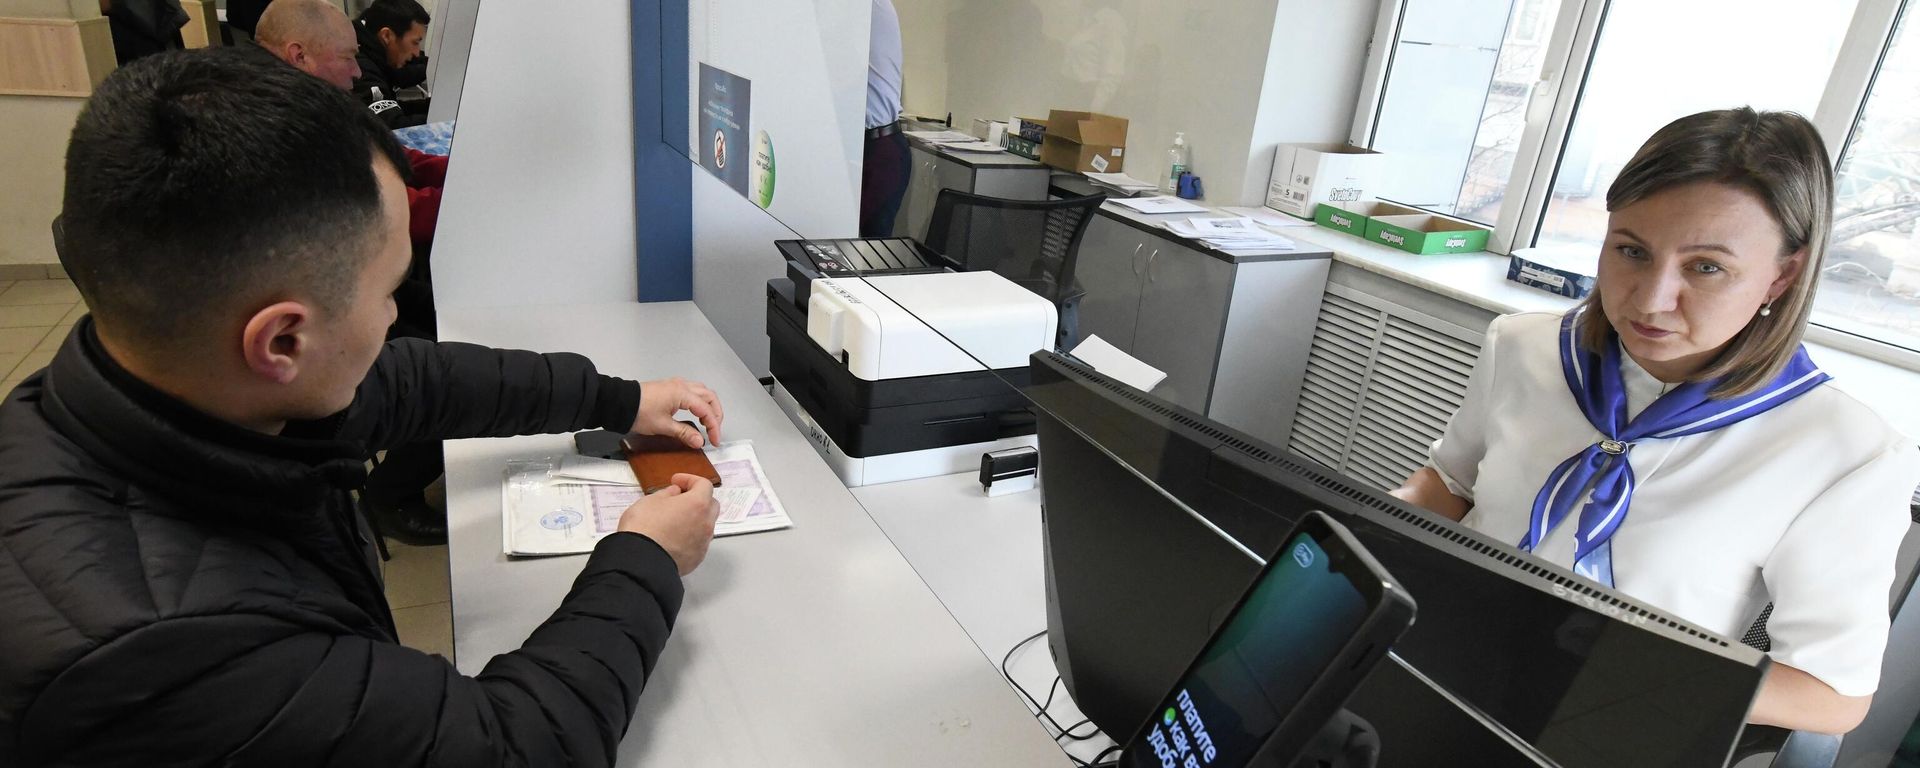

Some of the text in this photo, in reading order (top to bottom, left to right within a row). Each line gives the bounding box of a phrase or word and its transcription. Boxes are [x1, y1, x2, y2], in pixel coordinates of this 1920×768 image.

[1146, 722, 1179, 768] удоб
[1169, 720, 1191, 760] как
[1177, 689, 1216, 763] платите
